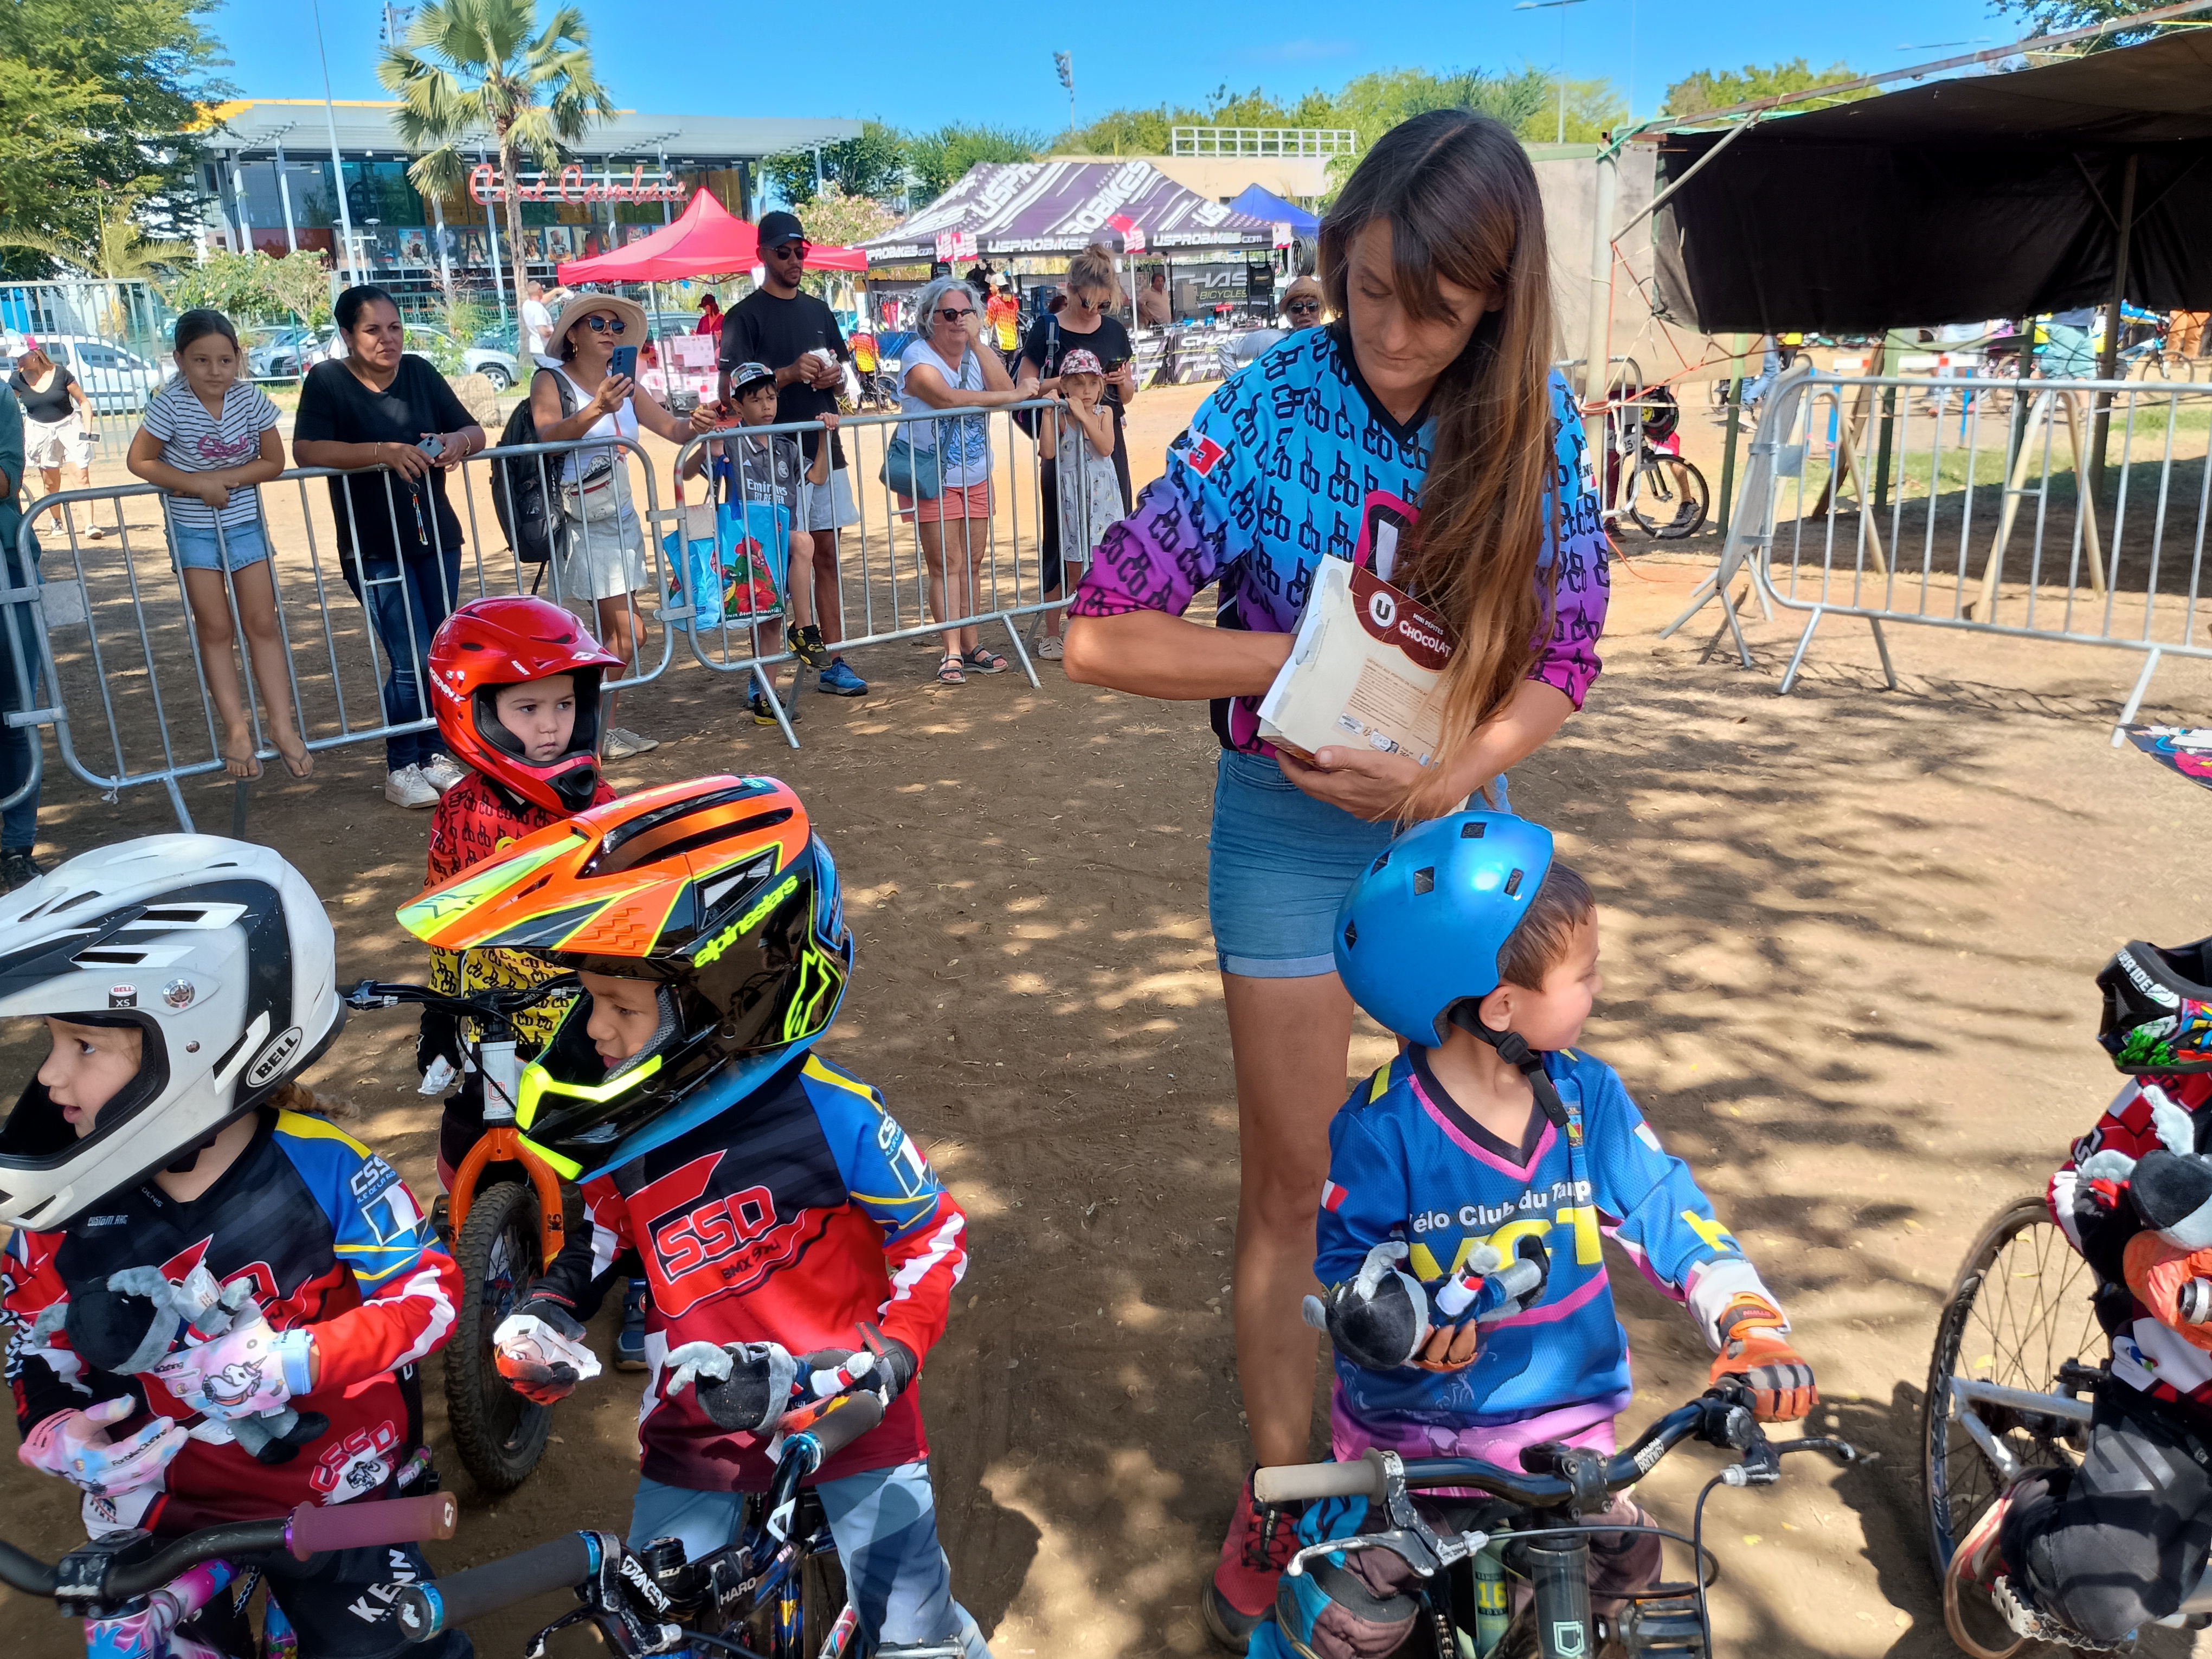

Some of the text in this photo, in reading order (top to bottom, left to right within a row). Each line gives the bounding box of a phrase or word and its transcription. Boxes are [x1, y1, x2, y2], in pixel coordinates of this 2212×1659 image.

[746, 478, 788, 496] Emirtes
[1375, 599, 1391, 620] U
[1399, 620, 1452, 658] CHOCOLAT
[693, 875, 799, 969] alpinestars
[115, 999, 130, 1007] XS
[255, 1037, 298, 1079] BELL
[1410, 1211, 1450, 1233] élo
[1459, 1201, 1515, 1226] Club
[1518, 1190, 1547, 1210] du
[309, 1419, 395, 1493] CSSD
[721, 1577, 757, 1605] HARO
[1477, 1581, 1507, 1609] 16
